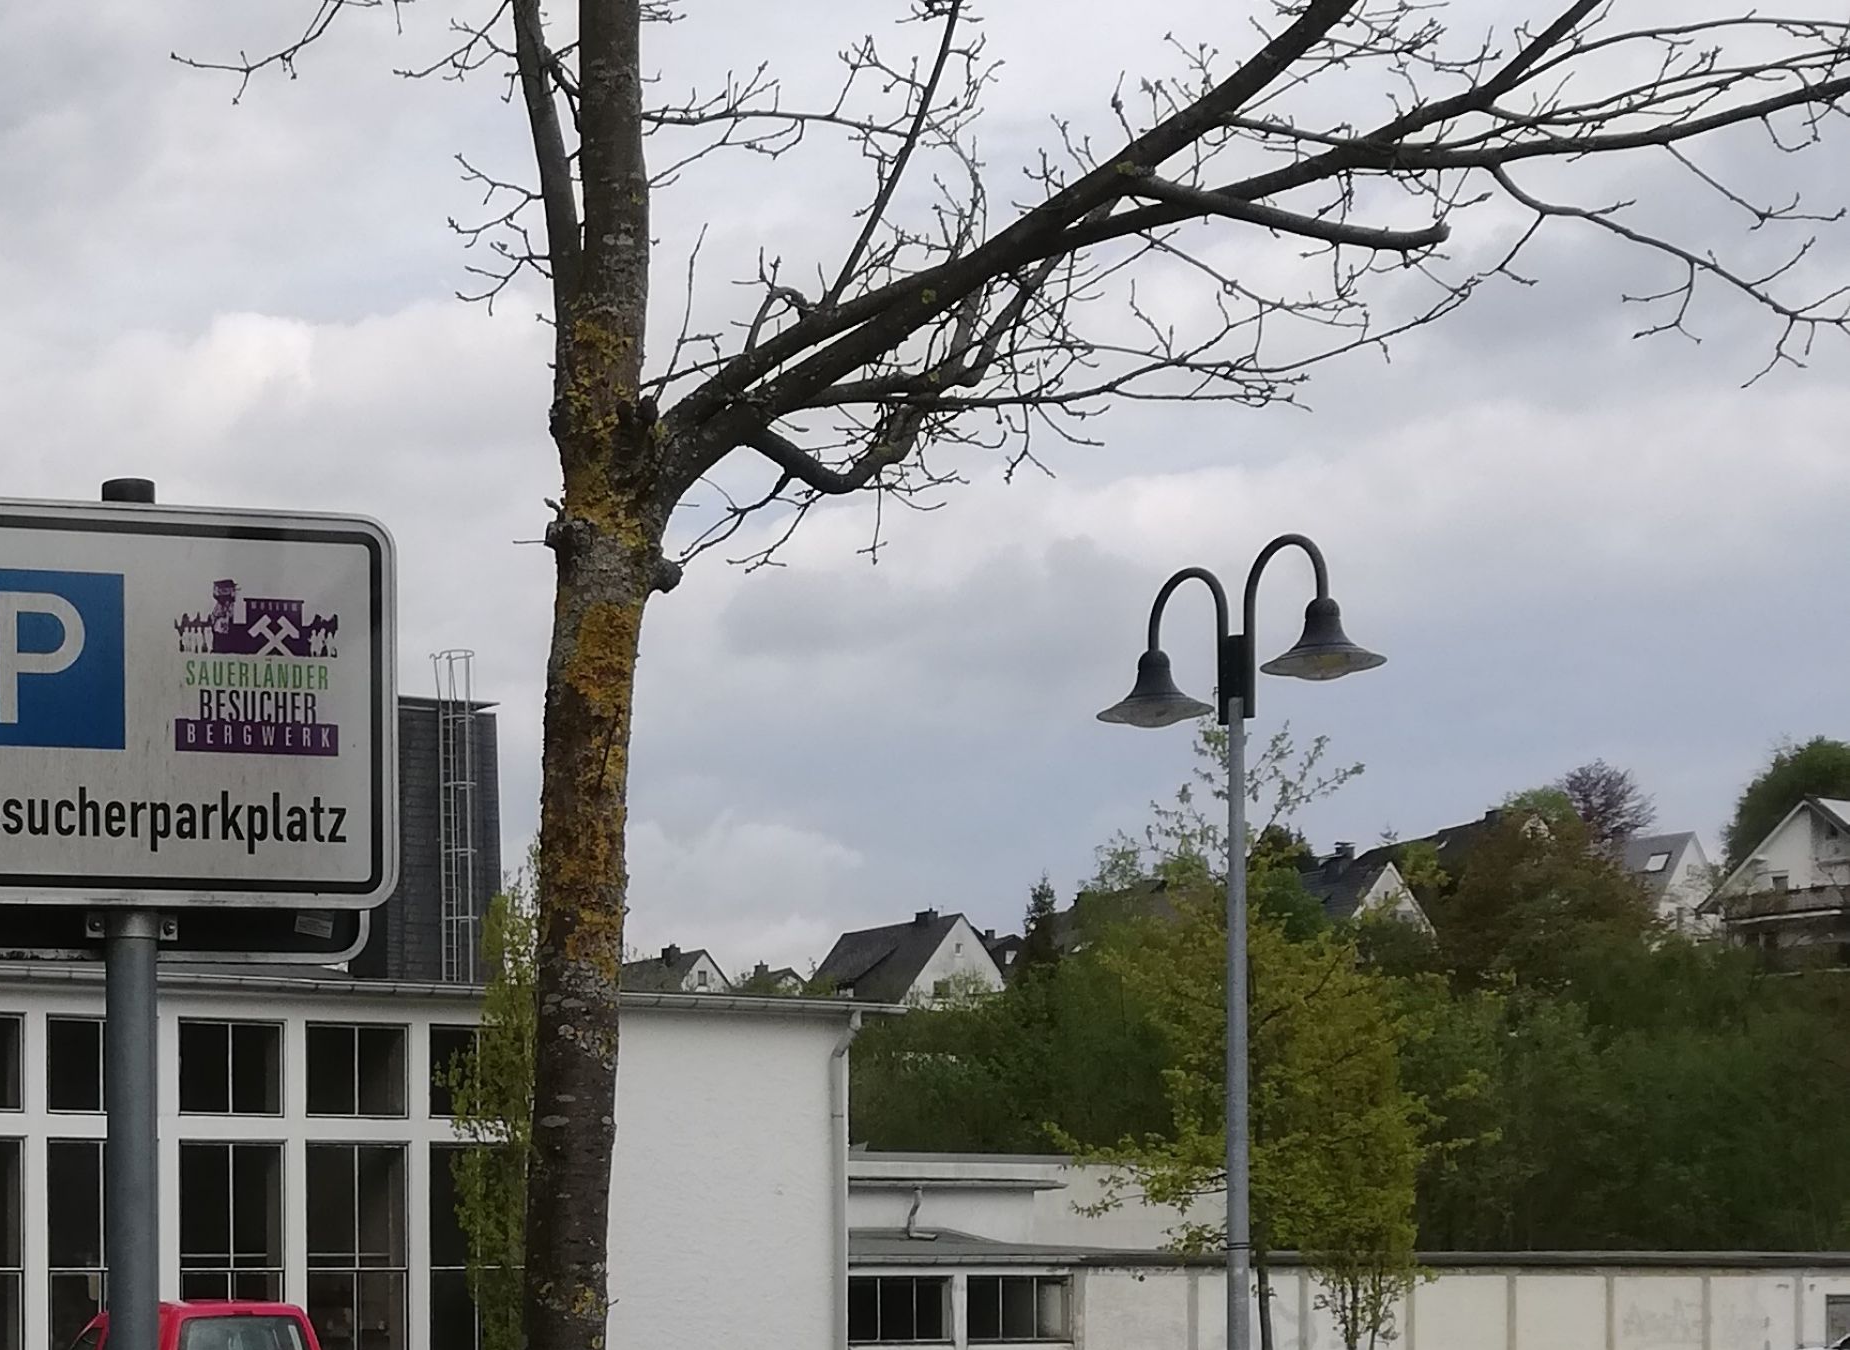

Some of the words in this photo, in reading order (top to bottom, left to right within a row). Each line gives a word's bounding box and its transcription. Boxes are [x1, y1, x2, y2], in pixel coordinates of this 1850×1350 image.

[185, 658, 329, 690] SAUERLÄNDER
[200, 689, 317, 724] BESUCHER
[186, 723, 331, 748] BERGWERK
